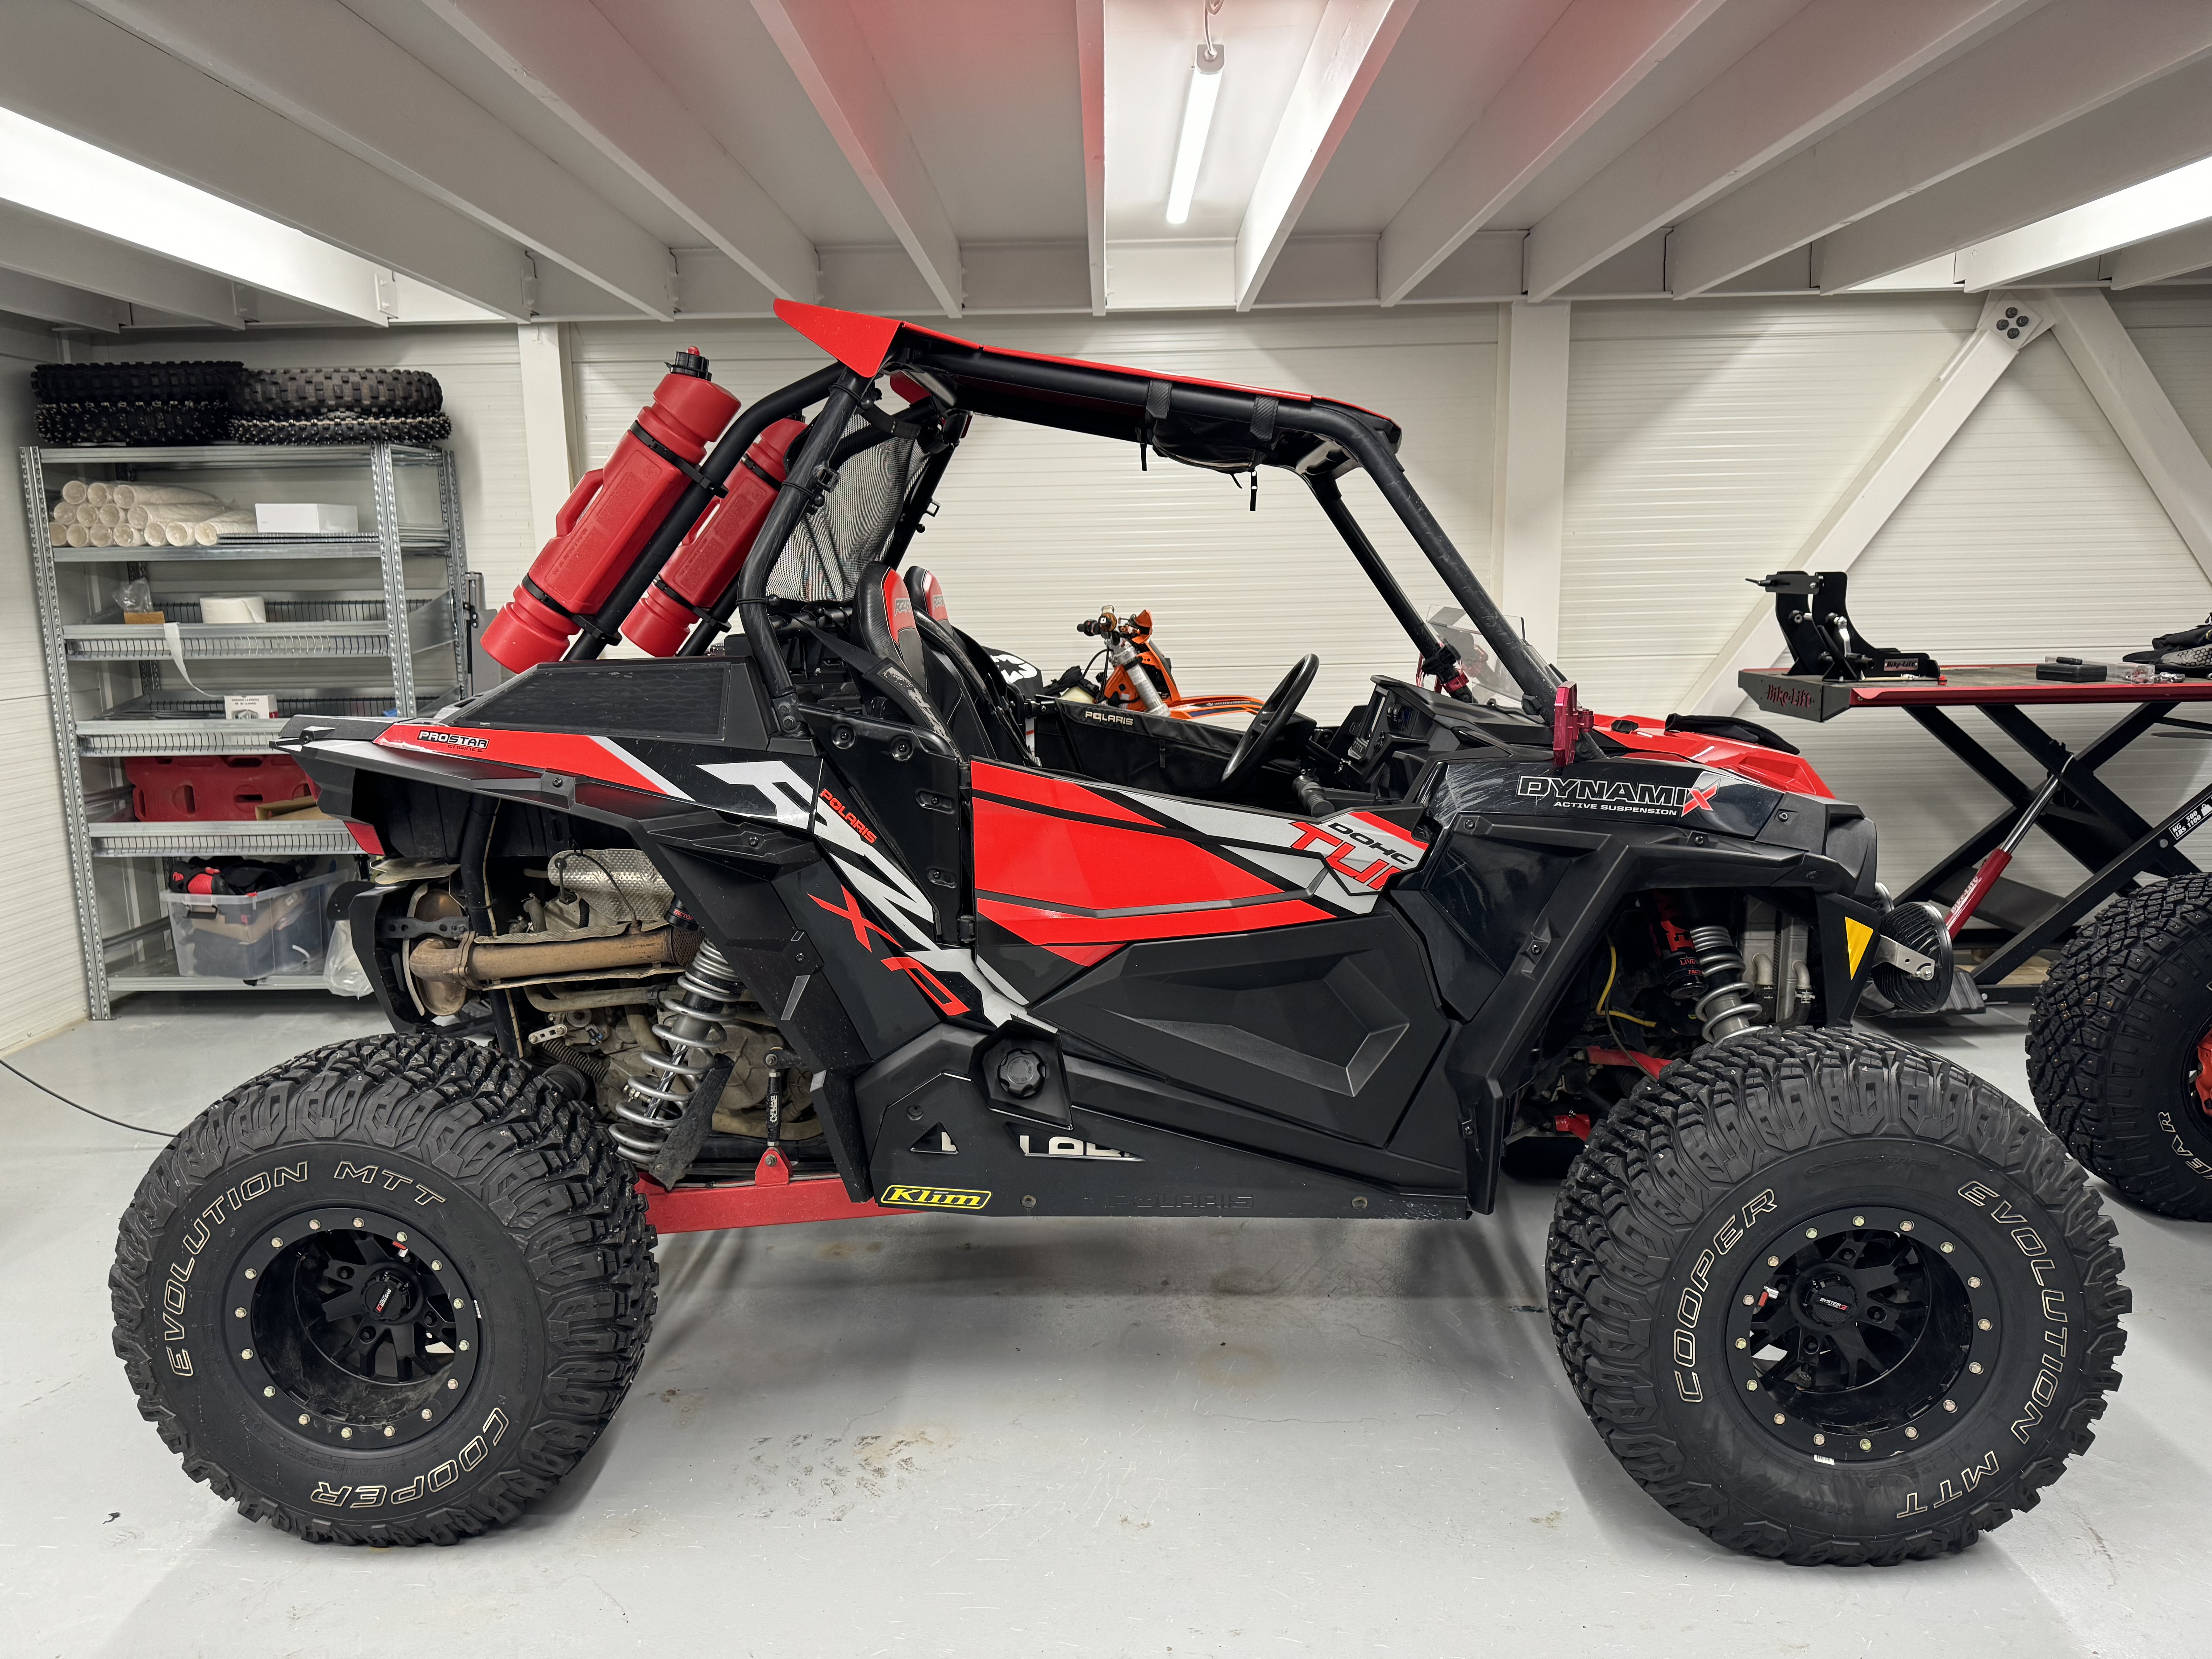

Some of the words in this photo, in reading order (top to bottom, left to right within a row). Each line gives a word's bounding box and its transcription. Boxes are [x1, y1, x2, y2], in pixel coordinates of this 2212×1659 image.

[418, 731, 488, 748] PROSTAR
[1085, 711, 1133, 726] POLARIS
[819, 788, 877, 844] POLARIS
[1517, 776, 1721, 817] DYNAMIX
[1554, 801, 1597, 810] ACTIVE
[1601, 804, 1677, 816] SUSPENSION
[1328, 822, 1414, 865] DOHC
[2172, 823, 2181, 833] KG
[2186, 811, 2198, 822] 500
[2175, 826, 2186, 837] LBS
[2187, 814, 2201, 828] 1100
[2158, 1112, 2212, 1180] EAR
[889, 1187, 981, 1207] Klim
[163, 1161, 308, 1377] EVOLUTION
[334, 1161, 446, 1206] MTT
[1674, 1187, 1778, 1403] COOPER
[1957, 1180, 2069, 1444] EVOLUTION
[310, 1407, 509, 1509] COOPER
[1896, 1450, 2000, 1519] MTT
